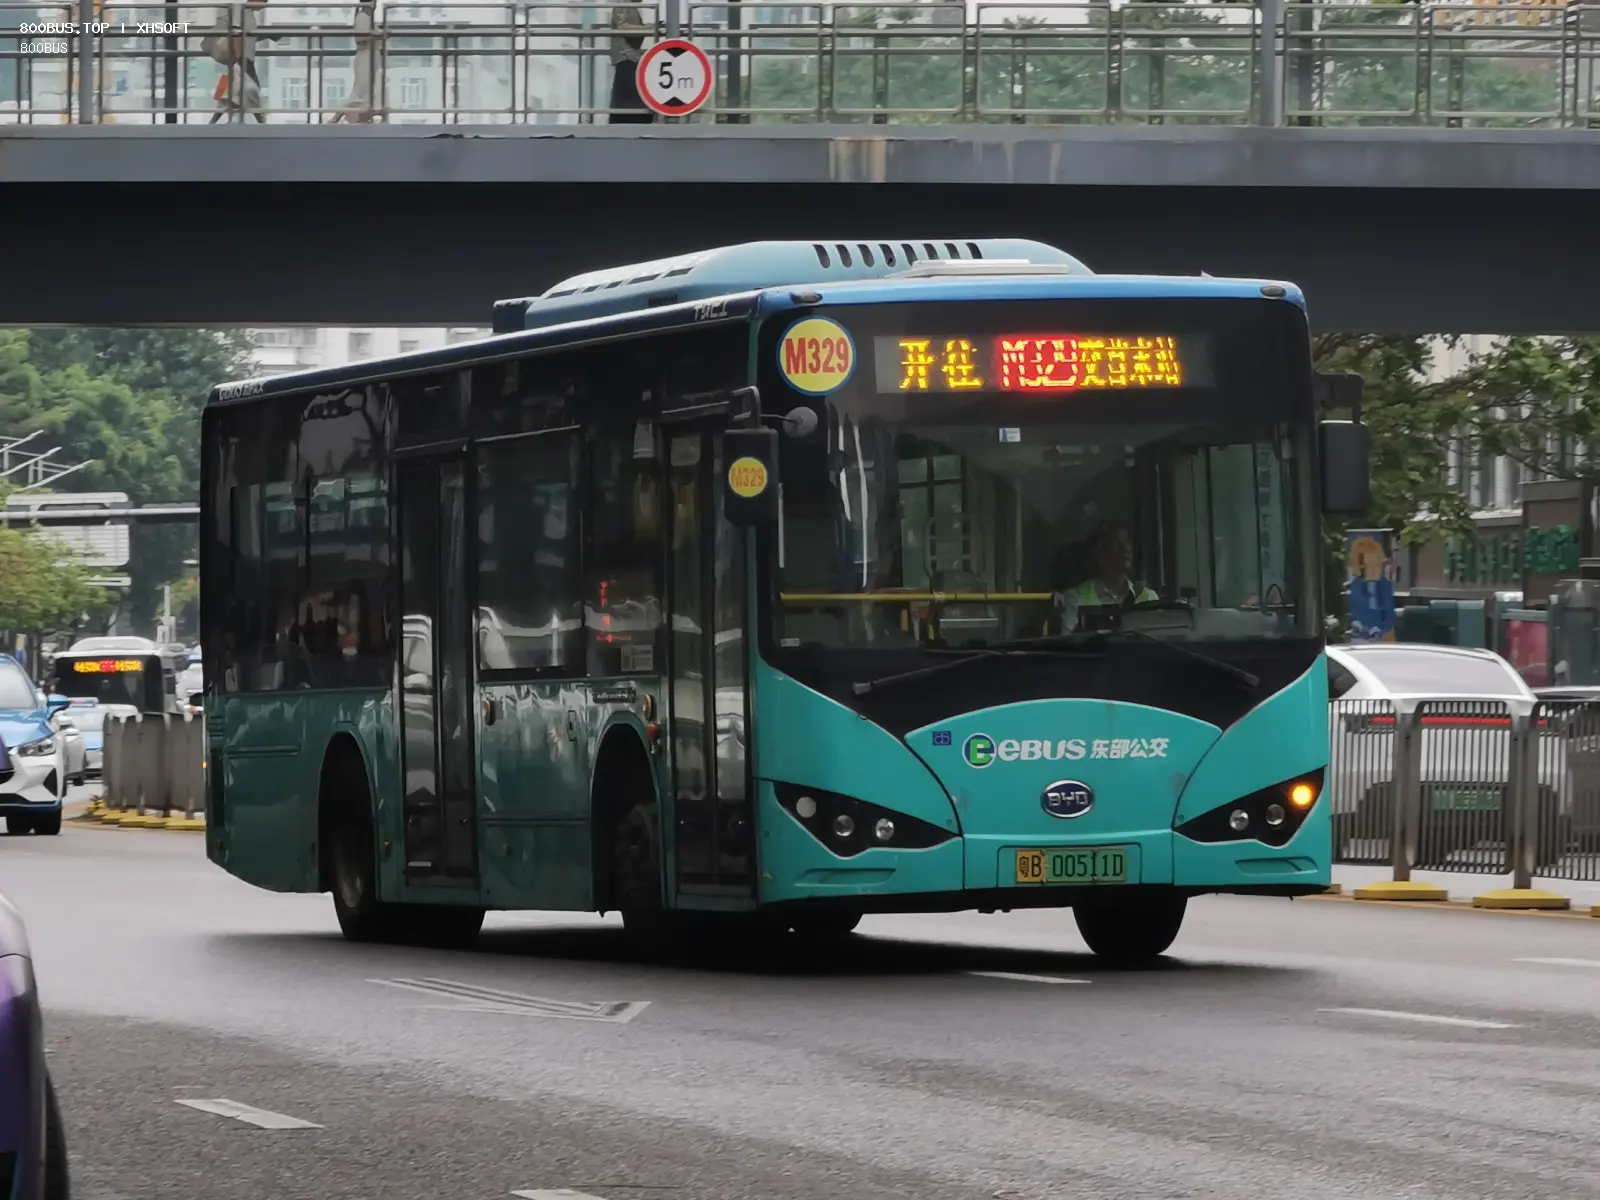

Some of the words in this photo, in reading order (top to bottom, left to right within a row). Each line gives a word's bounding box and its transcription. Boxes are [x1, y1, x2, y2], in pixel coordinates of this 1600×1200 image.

[658, 61, 695, 89] 5m
[785, 337, 850, 375] M329
[732, 467, 765, 488] M329
[1089, 737, 1169, 759] 东部公交
[1047, 791, 1089, 807] BYD
